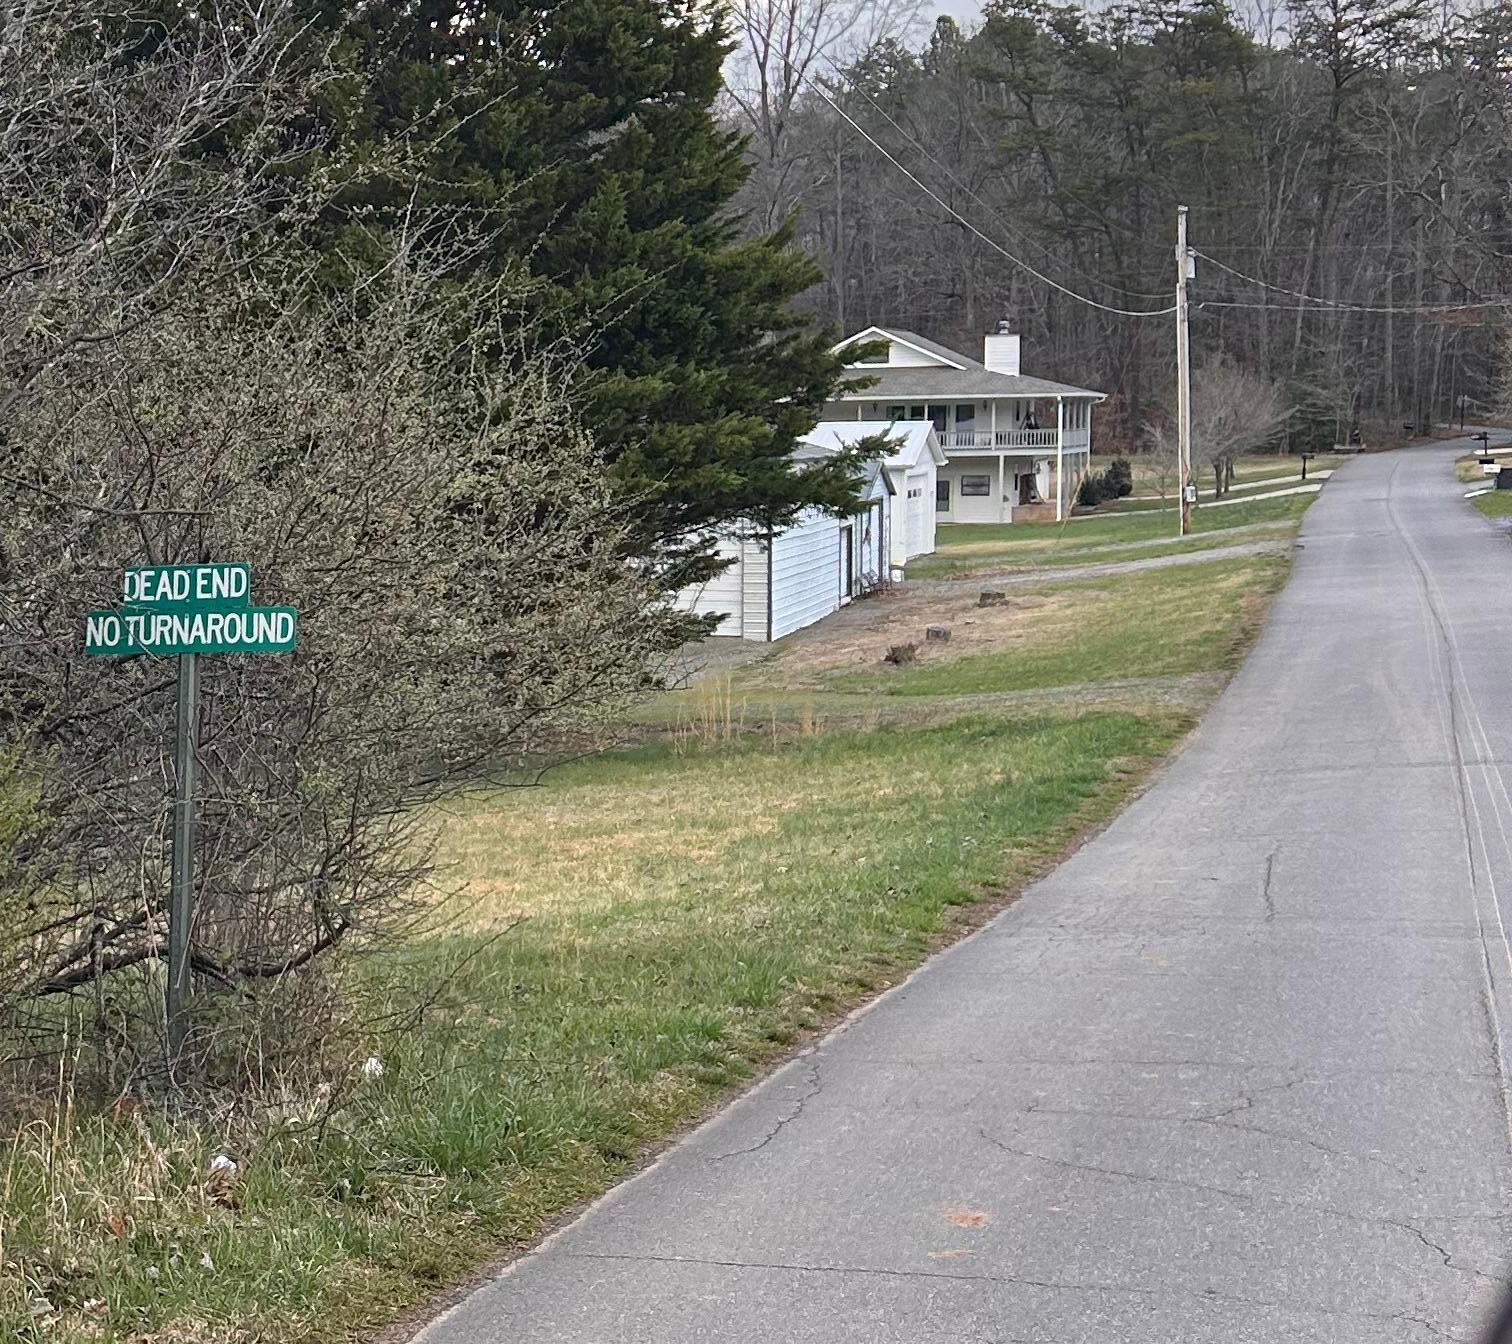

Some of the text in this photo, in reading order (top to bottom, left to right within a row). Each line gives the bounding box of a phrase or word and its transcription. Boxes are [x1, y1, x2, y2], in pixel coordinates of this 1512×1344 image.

[124, 567, 247, 601] DEAD END
[86, 613, 294, 647] NO TURNAROUND
